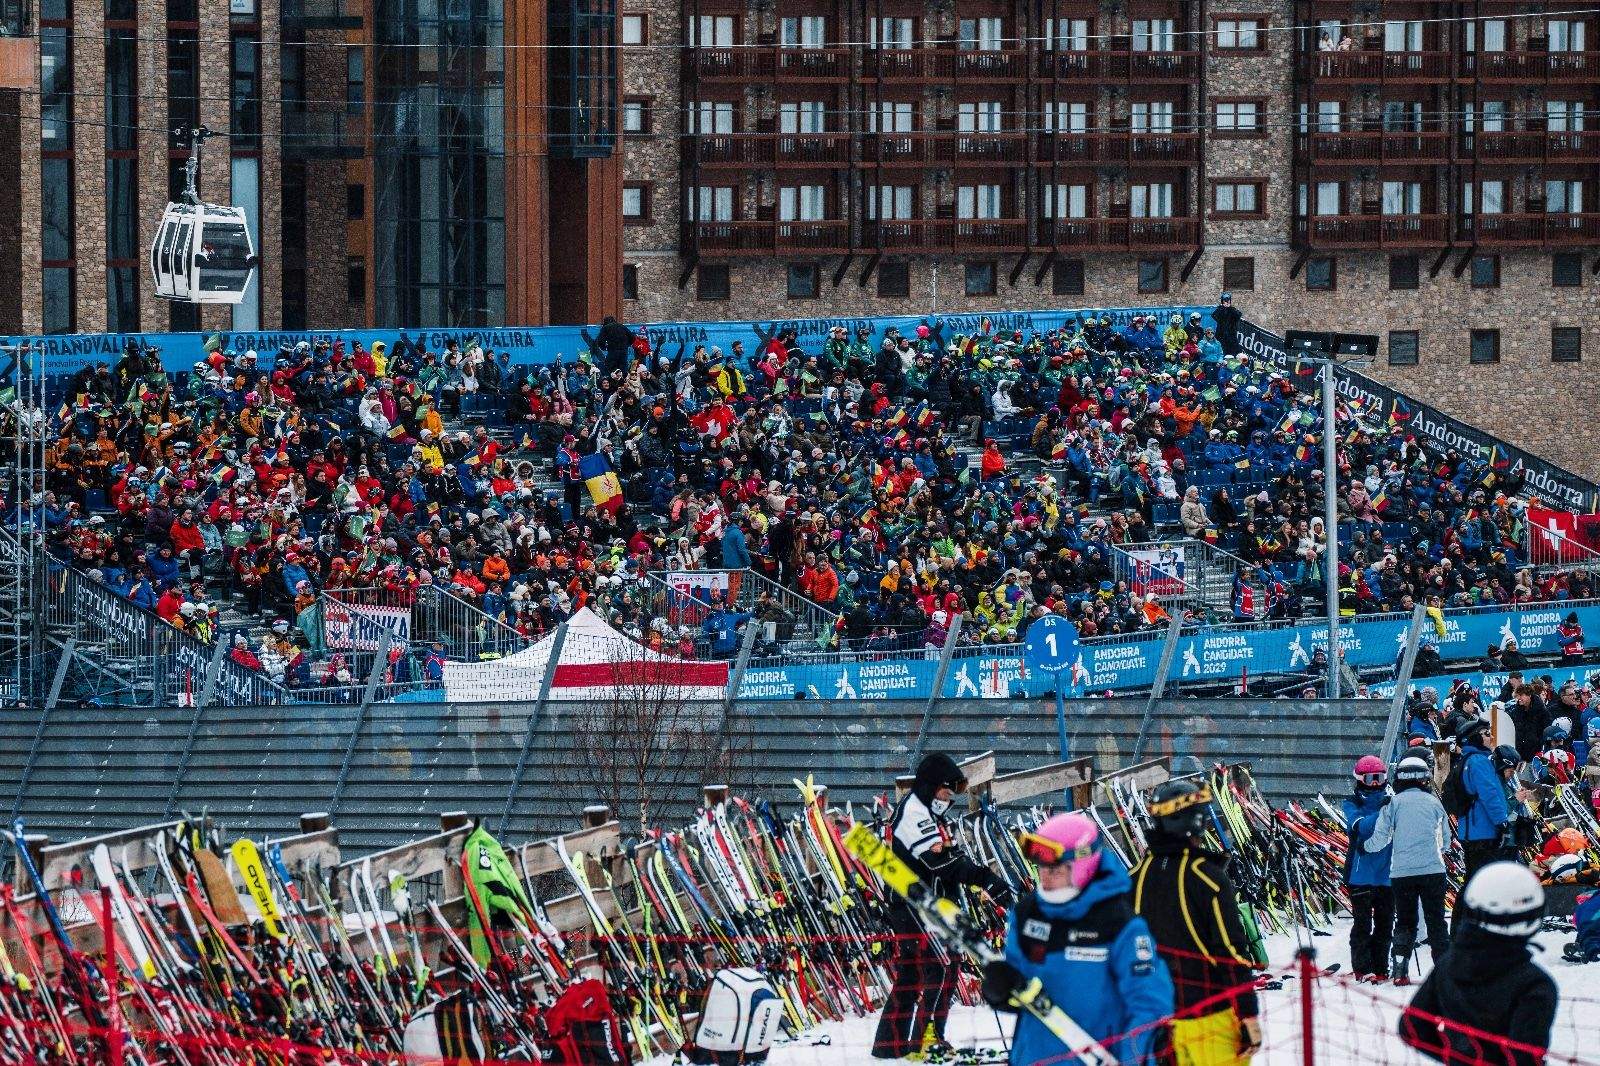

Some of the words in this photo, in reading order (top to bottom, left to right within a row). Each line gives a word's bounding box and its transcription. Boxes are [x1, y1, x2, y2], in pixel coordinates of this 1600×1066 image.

[1236, 330, 1287, 366] ndorra
[1410, 411, 1481, 458] Andorra
[1510, 458, 1583, 506] Andorra
[1521, 613, 1561, 625] ANDORRA
[1521, 625, 1557, 637] CANDIDA
[1046, 633, 1057, 657] 1
[1204, 636, 1246, 649] ANDORRA
[1521, 638, 1542, 648] 2029
[1094, 647, 1139, 660] ANDORRA
[1203, 648, 1253, 662] CANDIDATE
[859, 665, 908, 678] ANDORRA
[1095, 658, 1146, 673] CANDIDATE
[1203, 663, 1226, 674] 2029
[742, 671, 787, 684] NDORRA
[861, 677, 916, 690] CANDIDATE
[1094, 675, 1117, 685] 2029
[248, 864, 273, 916] HEAD
[758, 1007, 771, 1046] HEAD
